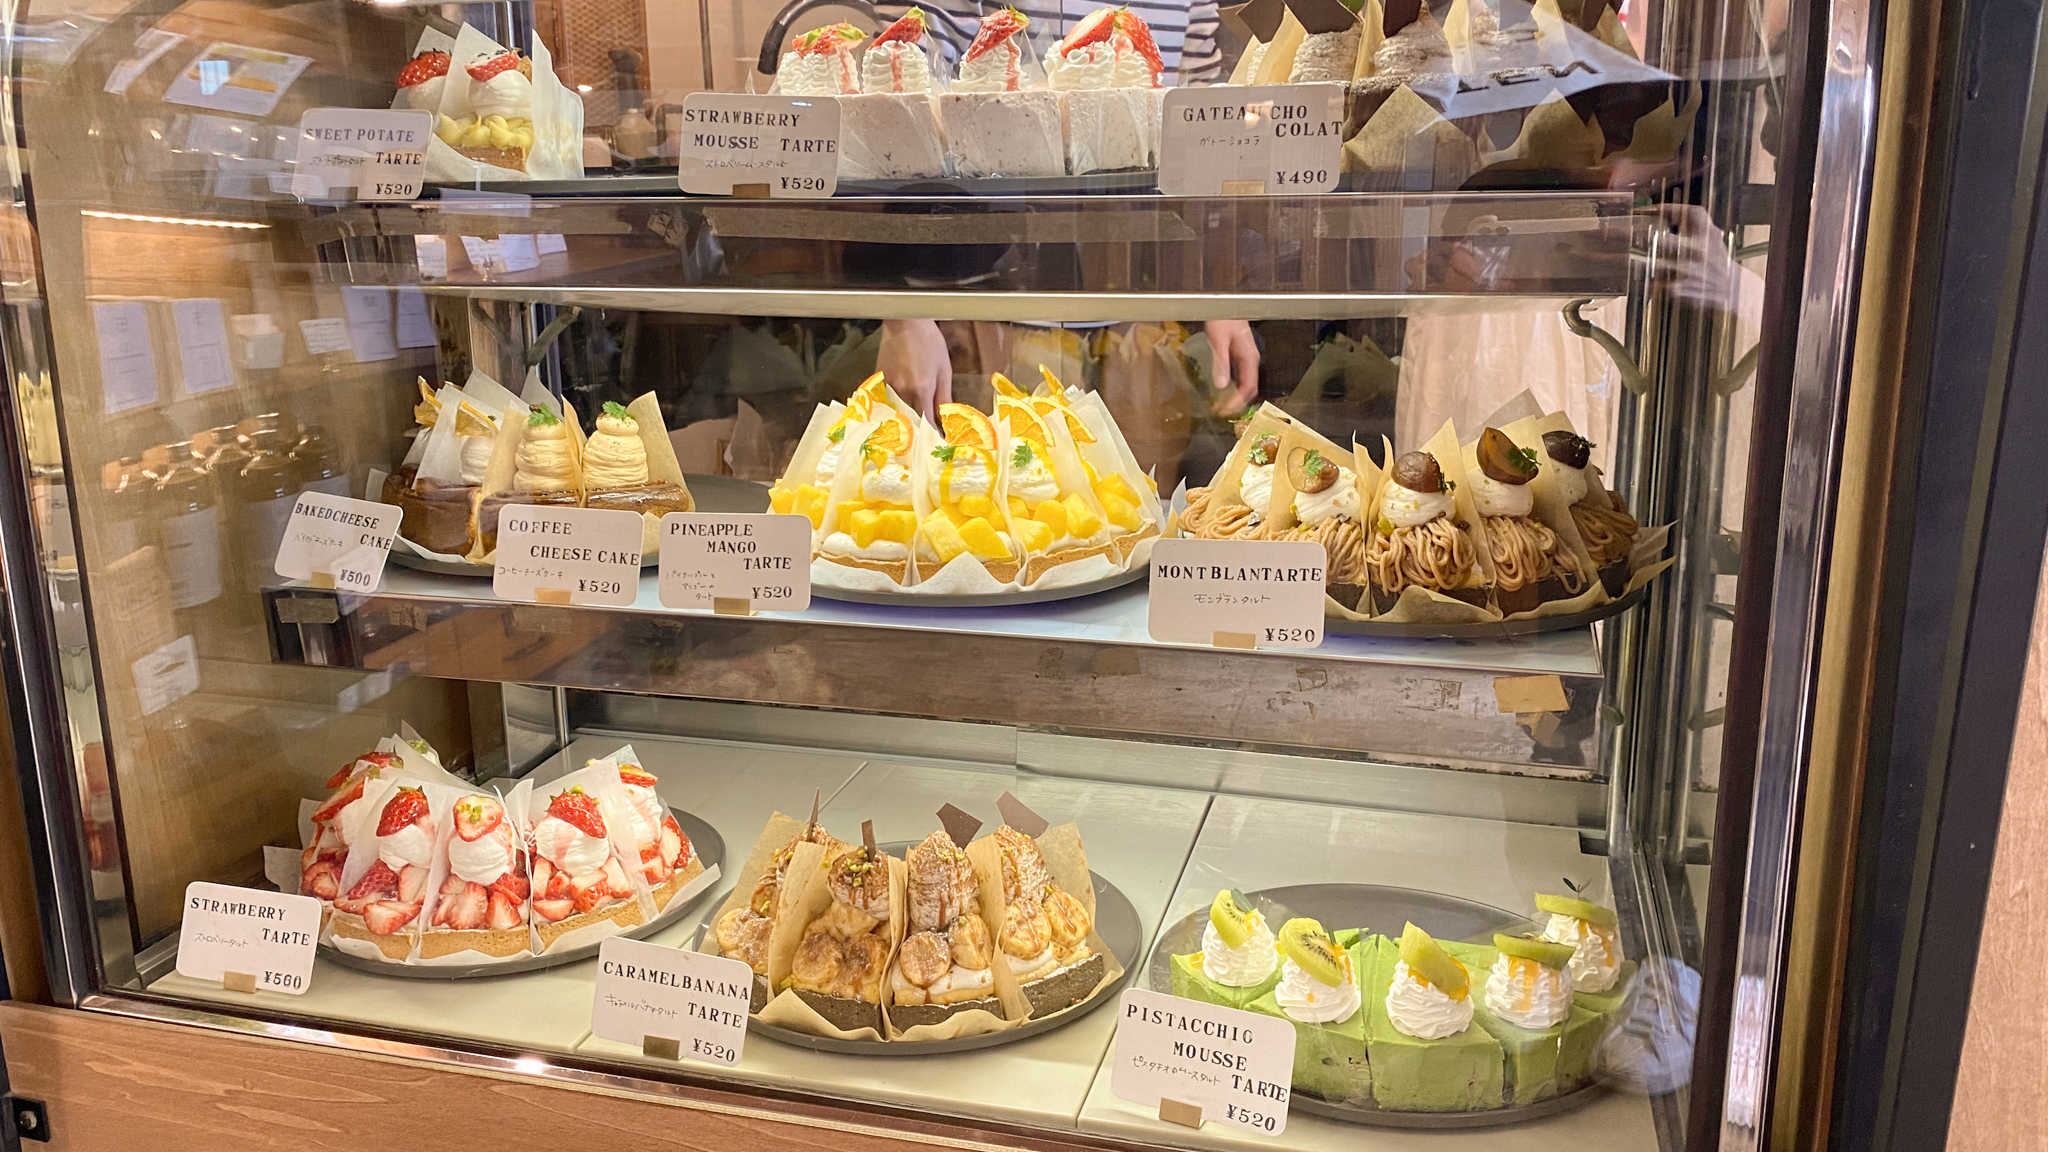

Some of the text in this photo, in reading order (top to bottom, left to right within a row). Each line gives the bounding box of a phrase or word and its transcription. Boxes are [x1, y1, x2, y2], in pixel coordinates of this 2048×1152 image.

[685, 109, 800, 127] STRAWBERRY
[1271, 105, 1307, 119] CHO
[306, 128, 415, 142] SWEET POTATE
[1275, 121, 1342, 137] COLAT
[694, 134, 836, 152] MOUSSE TARTE
[1200, 135, 1260, 146] ガトーショコラ
[376, 152, 421, 165] TARTE
[781, 176, 825, 190] ¥520
[1276, 170, 1327, 184] ¥490
[375, 183, 412, 195] ¥520
[509, 519, 572, 535] COFFEE
[670, 523, 753, 537] PINEAPPLE
[360, 534, 392, 550] CAKE
[707, 541, 756, 554] MANGO
[530, 545, 639, 566] CHEESE CAKE
[743, 557, 791, 570] TARTE
[340, 568, 370, 586] ¥500
[579, 579, 621, 594] ¥520
[752, 586, 792, 599] ¥520
[1194, 592, 1270, 604] モンブランタルト
[1265, 628, 1315, 642] ¥520
[191, 897, 286, 921] STRAWBERRY
[262, 928, 310, 946] TARTE
[264, 971, 302, 990] ¥560
[688, 1002, 742, 1029] TARTE
[1126, 1003, 1253, 1044] PISTACCHIO
[693, 1038, 735, 1063] ¥520
[1173, 1041, 1247, 1072] MOUSSE
[1232, 1074, 1288, 1103] TARTE
[1226, 1103, 1276, 1132] ¥520
